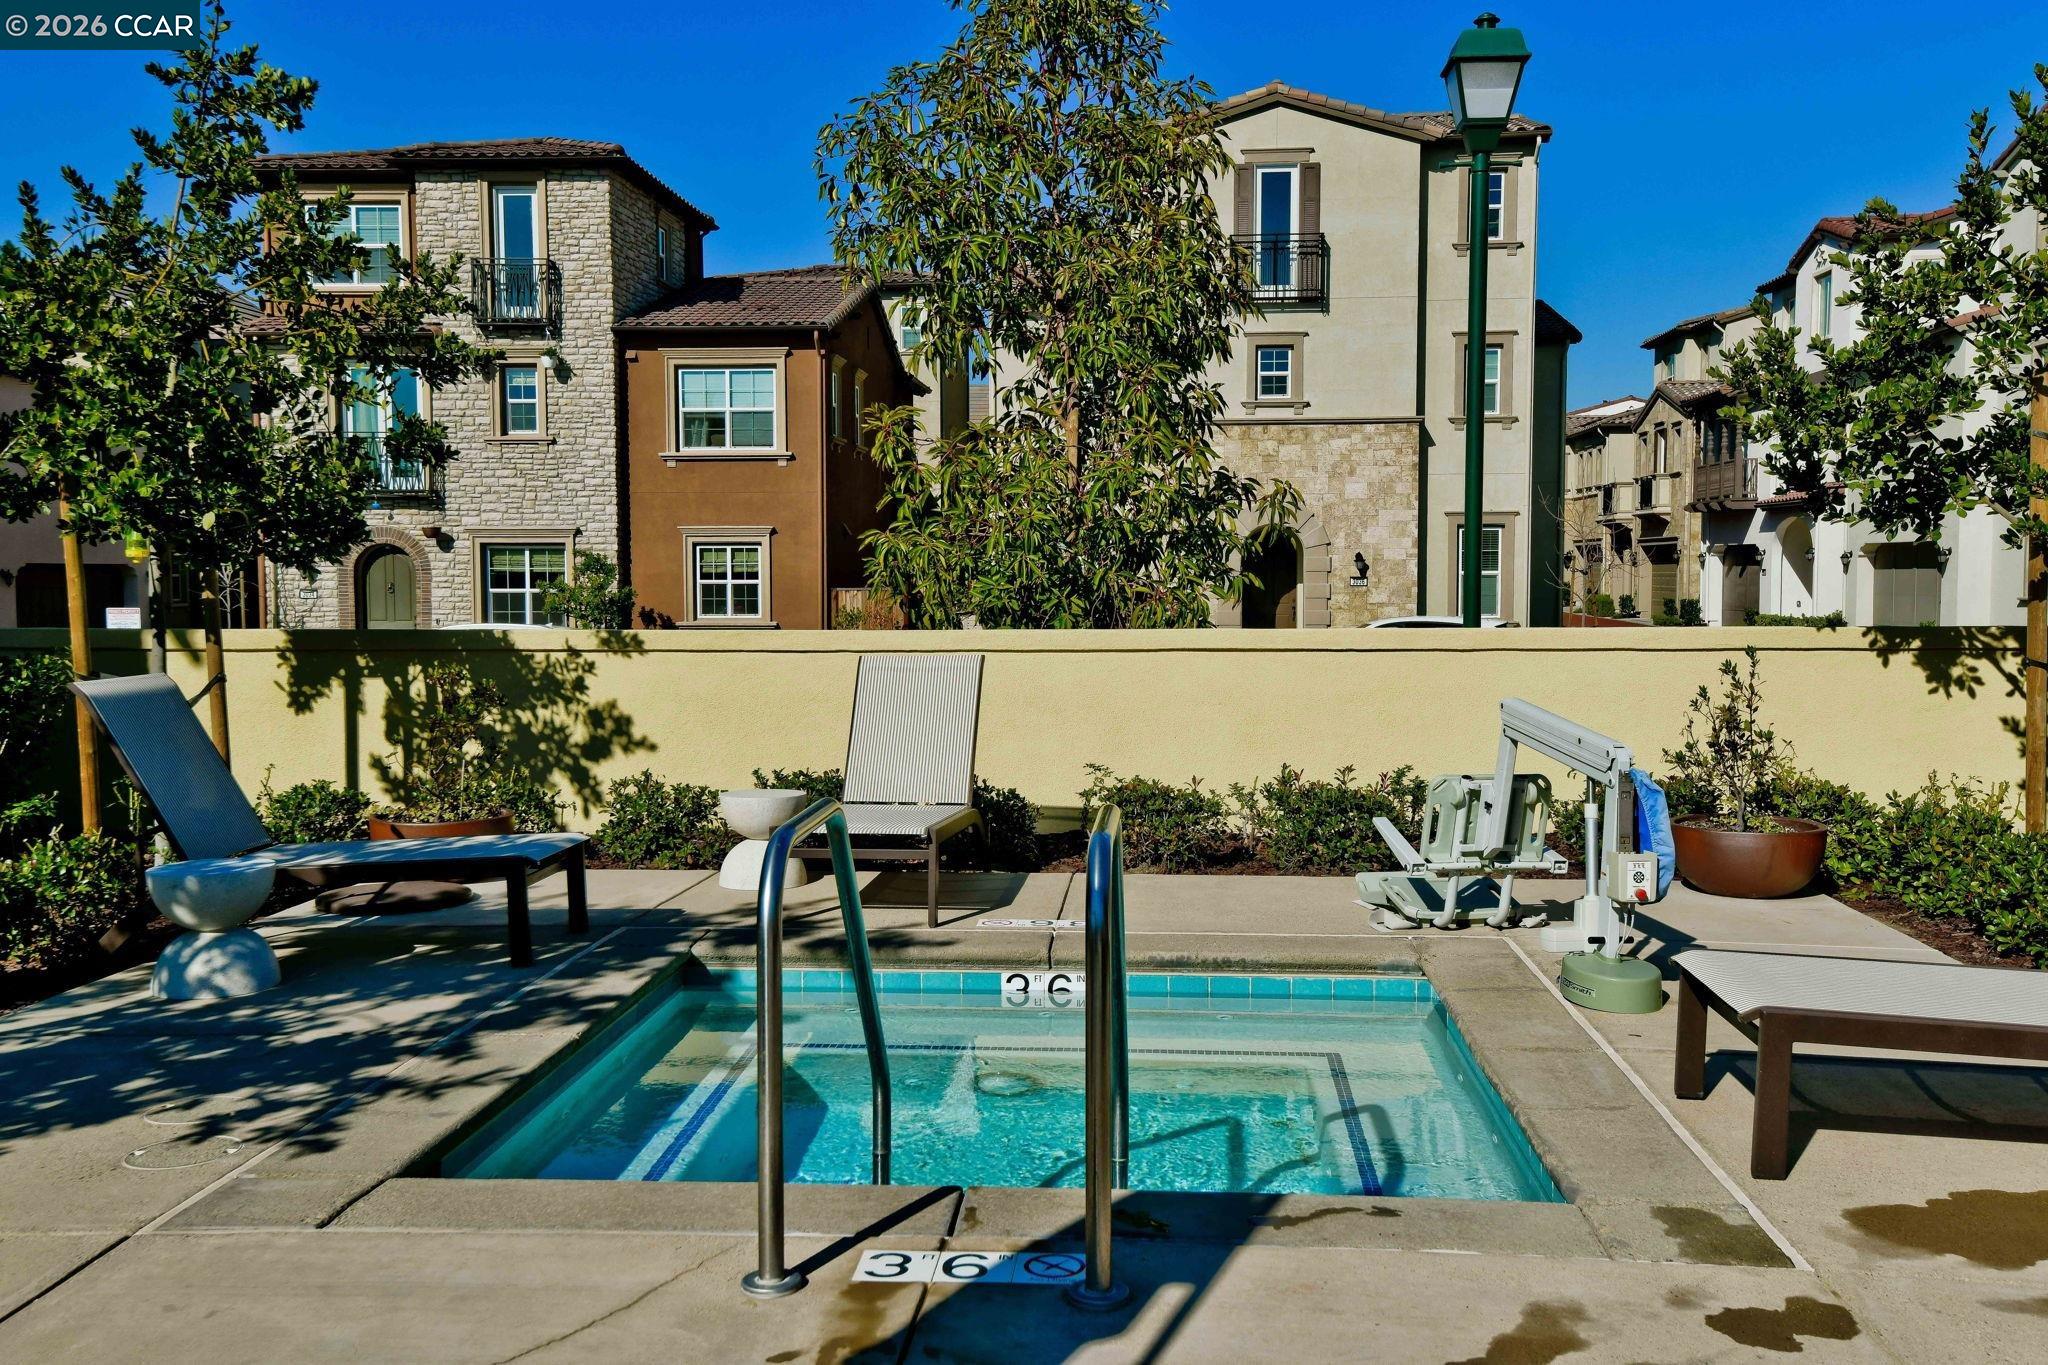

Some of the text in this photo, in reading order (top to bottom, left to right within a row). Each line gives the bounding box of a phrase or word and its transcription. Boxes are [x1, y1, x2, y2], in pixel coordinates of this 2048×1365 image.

[1006, 973, 1030, 994] 3
[864, 1253, 912, 1277] 3
[942, 1253, 988, 1279] 6
